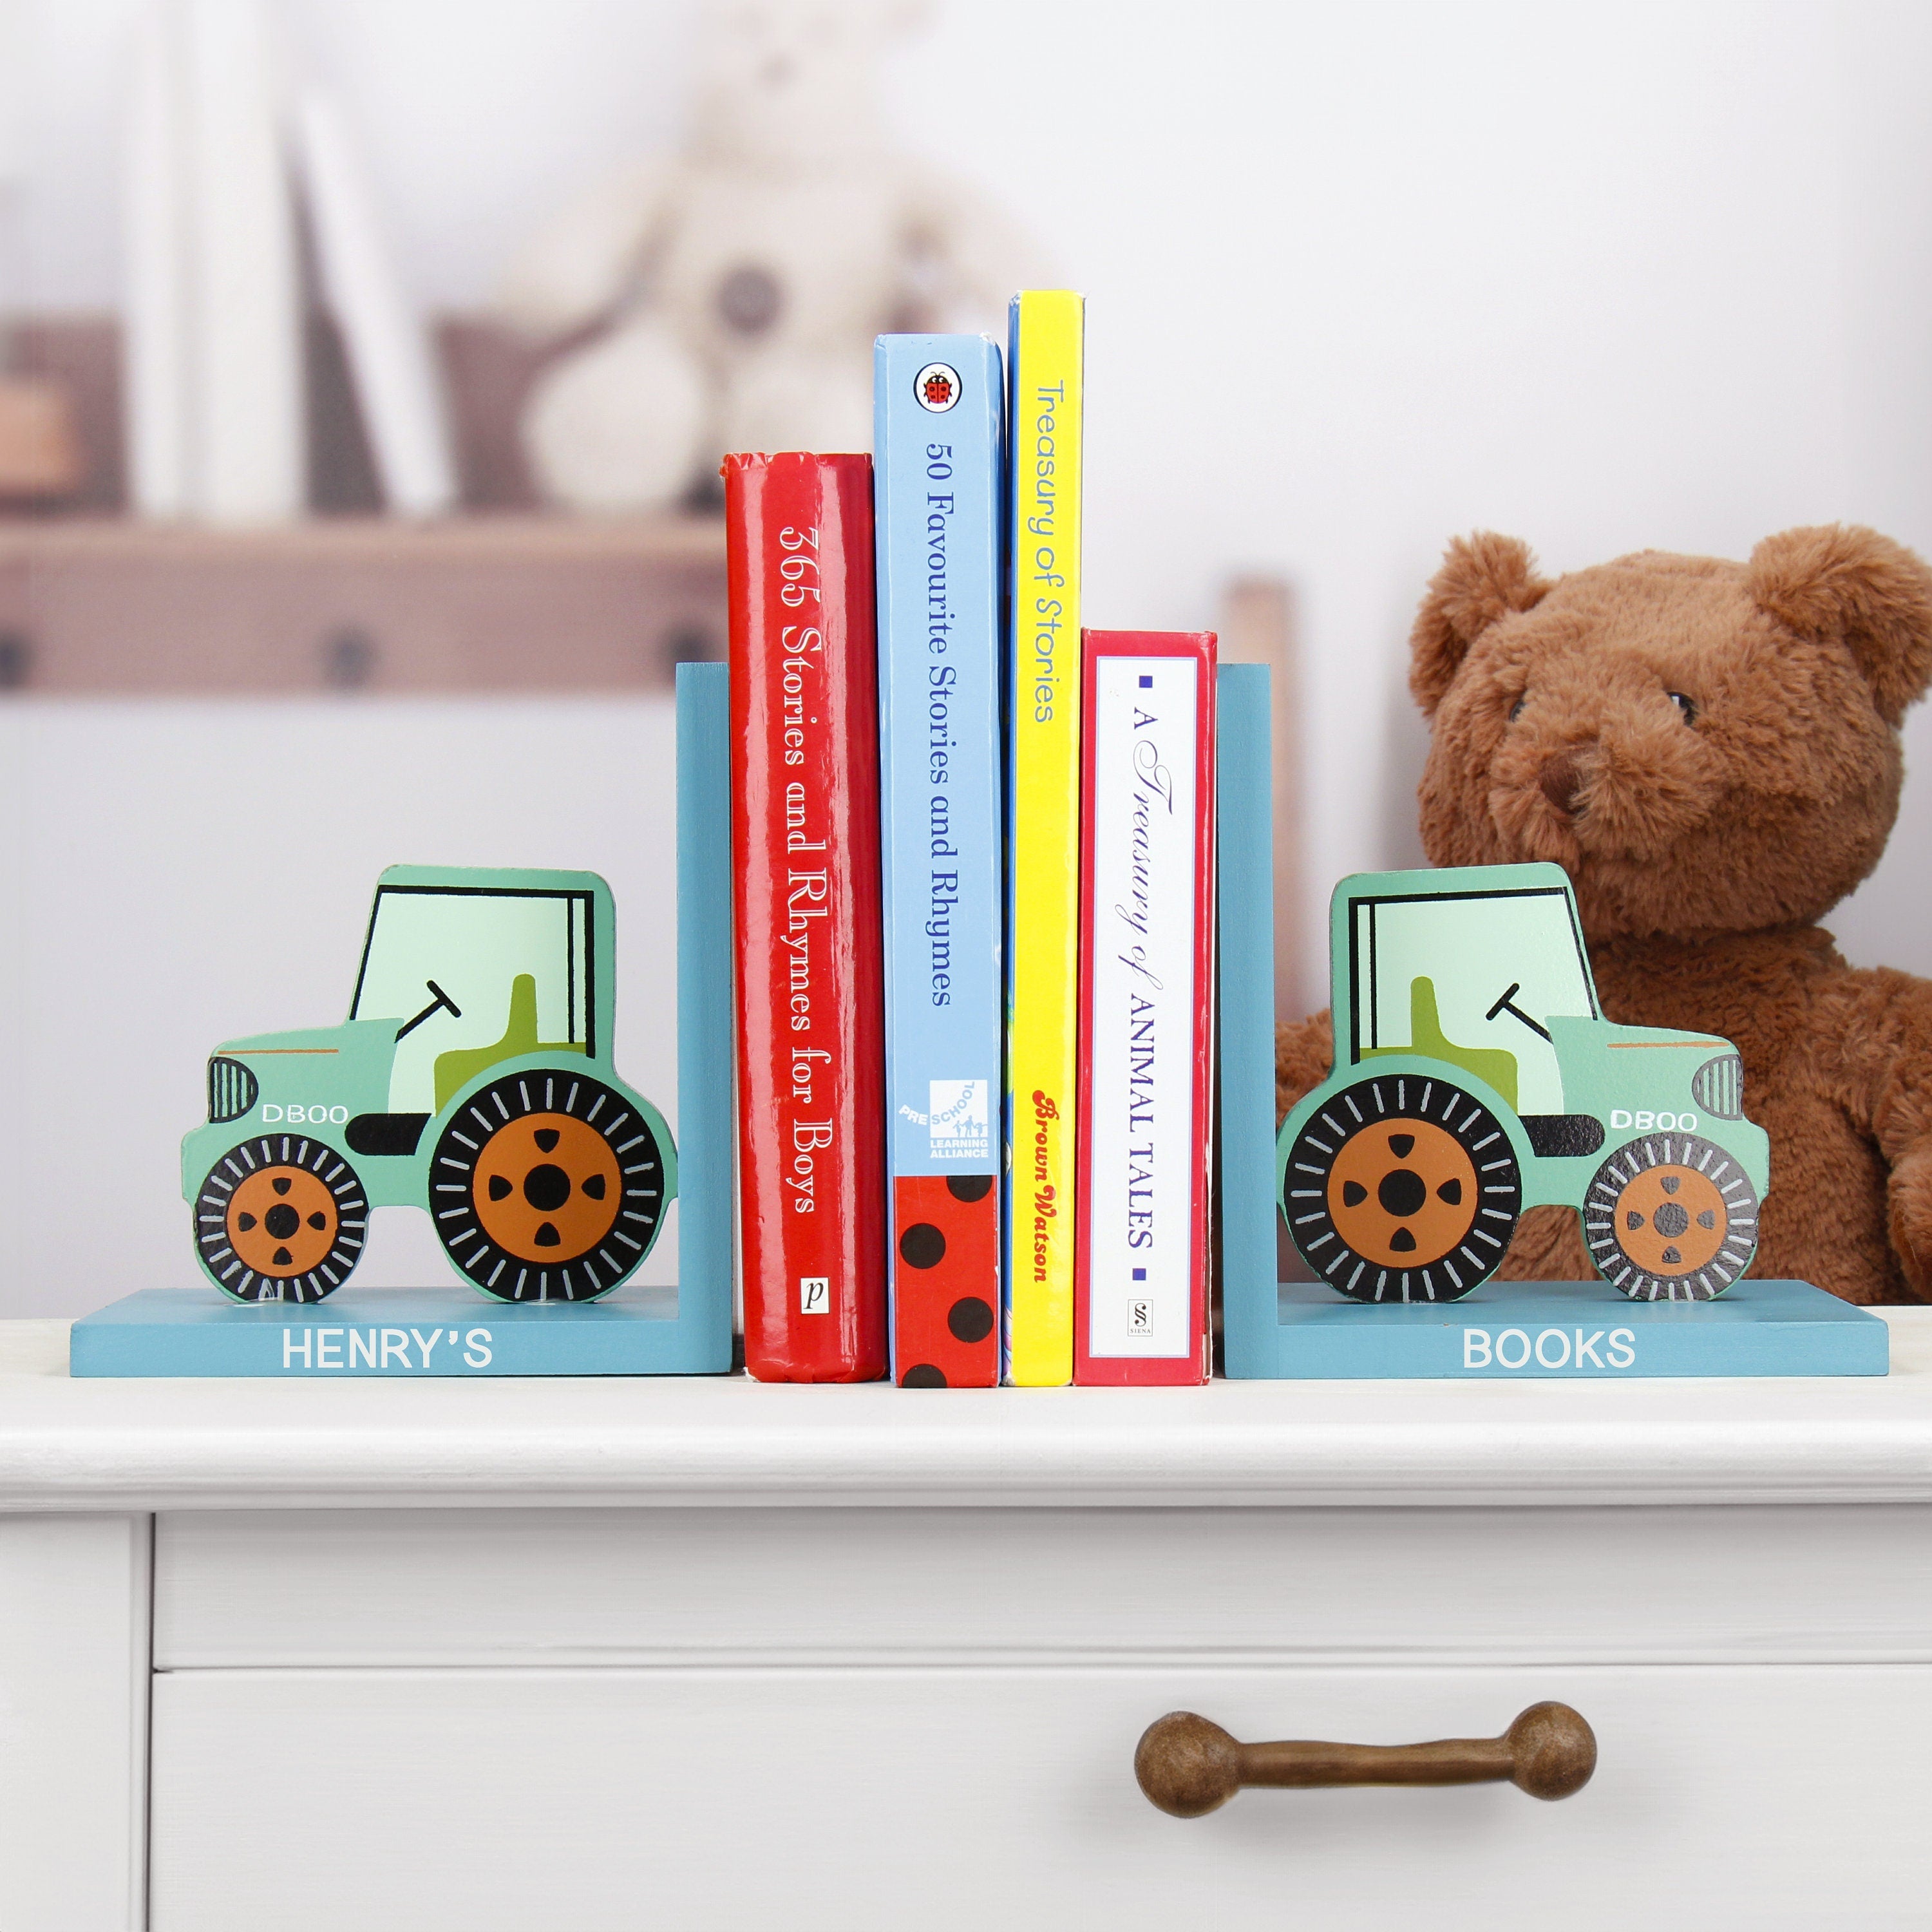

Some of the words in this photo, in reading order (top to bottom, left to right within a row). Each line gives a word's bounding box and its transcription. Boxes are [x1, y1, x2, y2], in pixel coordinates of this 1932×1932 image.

[926, 444, 952, 480] 50
[1027, 379, 1064, 536] Treasury
[779, 527, 821, 607] 365
[927, 491, 954, 654] Favourite
[1034, 547, 1065, 587] of
[782, 626, 822, 765] Stories
[1035, 598, 1062, 723] Stories
[929, 666, 956, 784] Stories
[1134, 706, 1158, 730] A
[786, 782, 826, 855] and
[930, 795, 958, 858] and
[1115, 740, 1172, 936] Treasury
[780, 867, 828, 1031] Rhymes
[925, 869, 958, 1007] Rhymes
[1118, 945, 1163, 990] of
[792, 1046, 831, 1104] for
[898, 1104, 928, 1125] PRE
[931, 1081, 975, 1124] SCHOOL
[1130, 993, 1155, 1133] ANIMAL
[786, 1117, 833, 1213] Boys
[930, 1139, 989, 1148] LEARNING
[930, 1149, 989, 1159] ALLIANCE
[1032, 1090, 1059, 1182] Brown
[1034, 1186, 1057, 1283] Watson
[1128, 1142, 1153, 1249] TALES
[283, 1328, 493, 1368] HENRY'S
[1464, 1328, 1636, 1368] BOOKS
